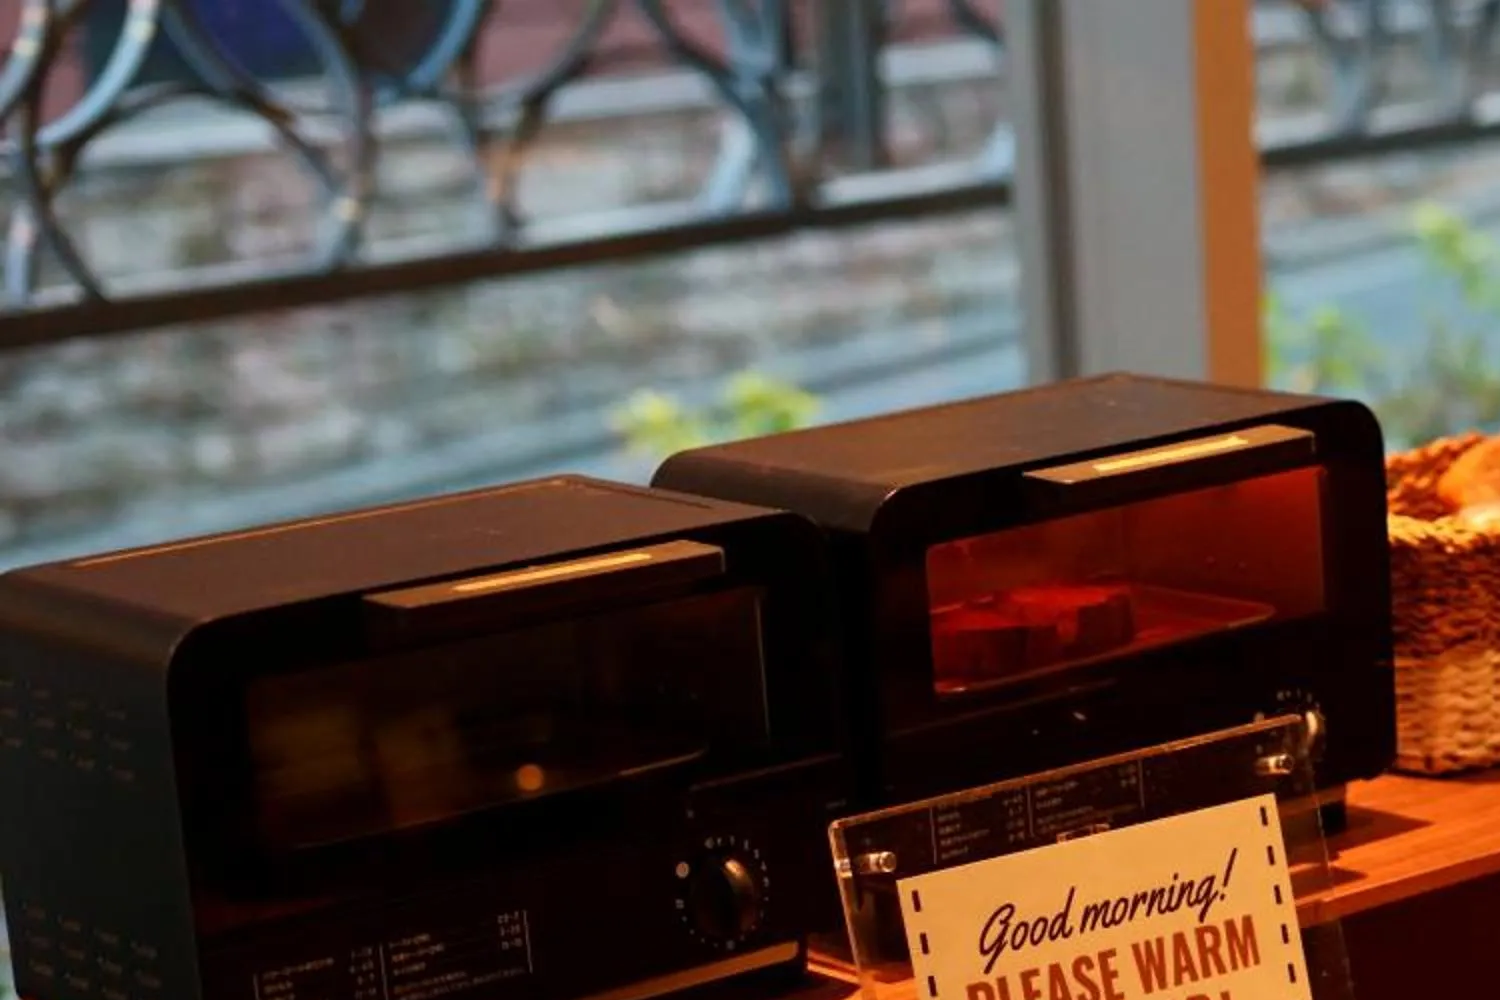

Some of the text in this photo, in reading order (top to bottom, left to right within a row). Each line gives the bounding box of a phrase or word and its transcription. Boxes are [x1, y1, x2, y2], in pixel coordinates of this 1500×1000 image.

[979, 848, 1237, 975] Good morning!
[1131, 914, 1261, 995] WARM
